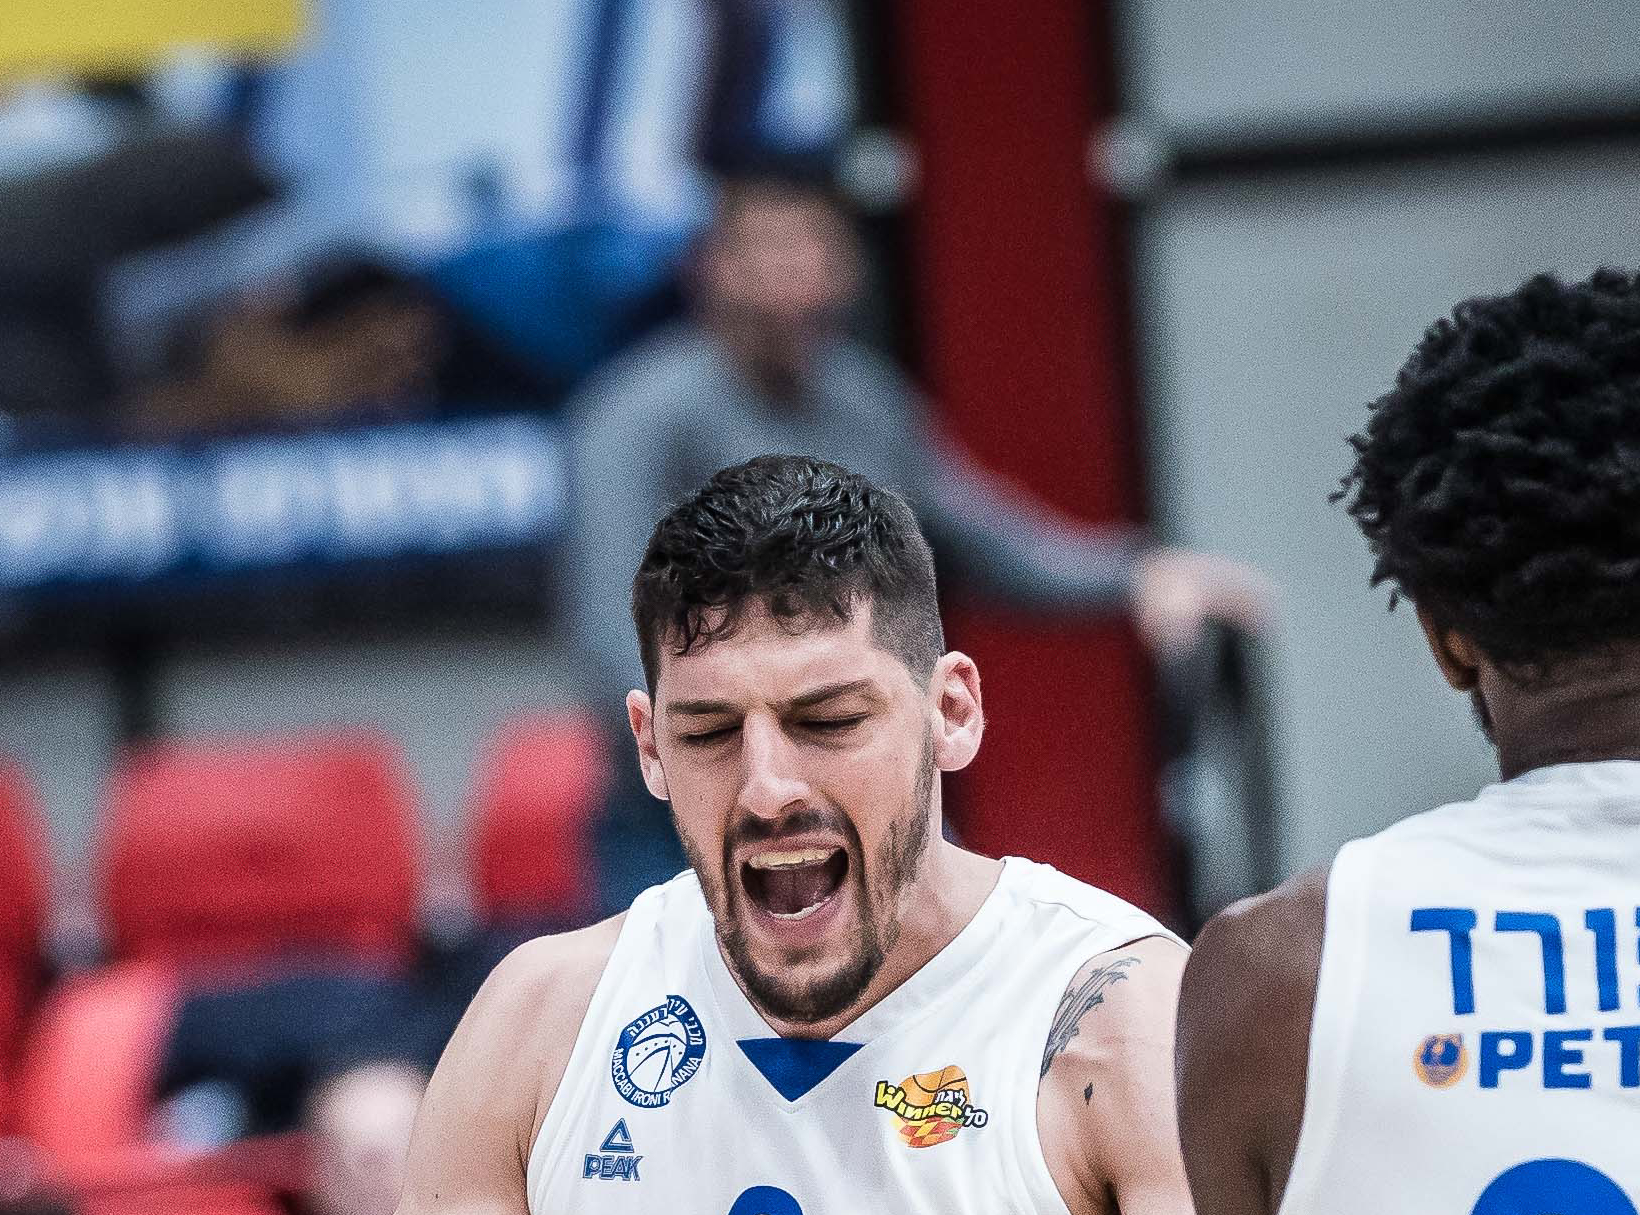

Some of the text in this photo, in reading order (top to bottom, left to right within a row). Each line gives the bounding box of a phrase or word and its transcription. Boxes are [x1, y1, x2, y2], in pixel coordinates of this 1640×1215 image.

[612, 1047, 702, 1106] MACCABI IRONI RNANA
[874, 1081, 964, 1120] Winner
[583, 1153, 644, 1181] PEAK
